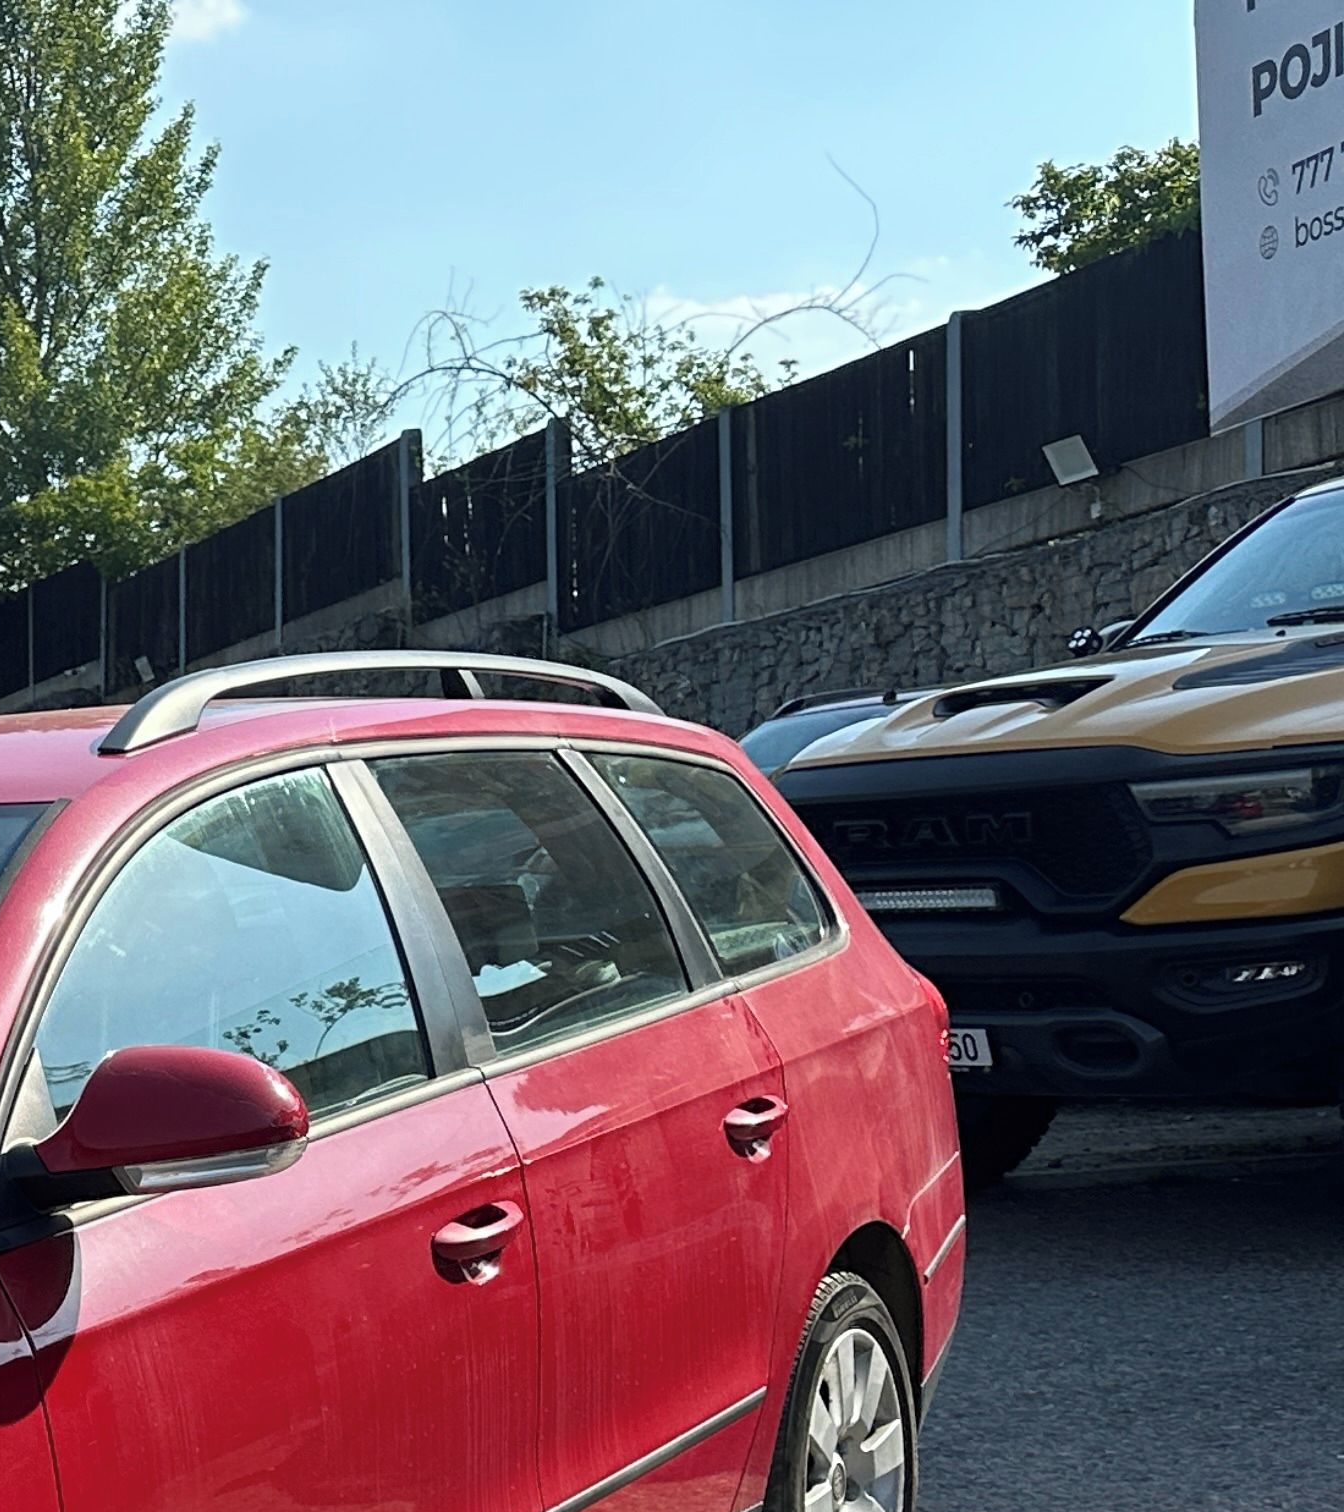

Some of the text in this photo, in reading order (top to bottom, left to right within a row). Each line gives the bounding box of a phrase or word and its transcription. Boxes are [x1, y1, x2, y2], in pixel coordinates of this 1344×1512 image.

[1292, 146, 1334, 195] 777
[1294, 206, 1344, 249] boss
[833, 812, 1032, 849] RAM
